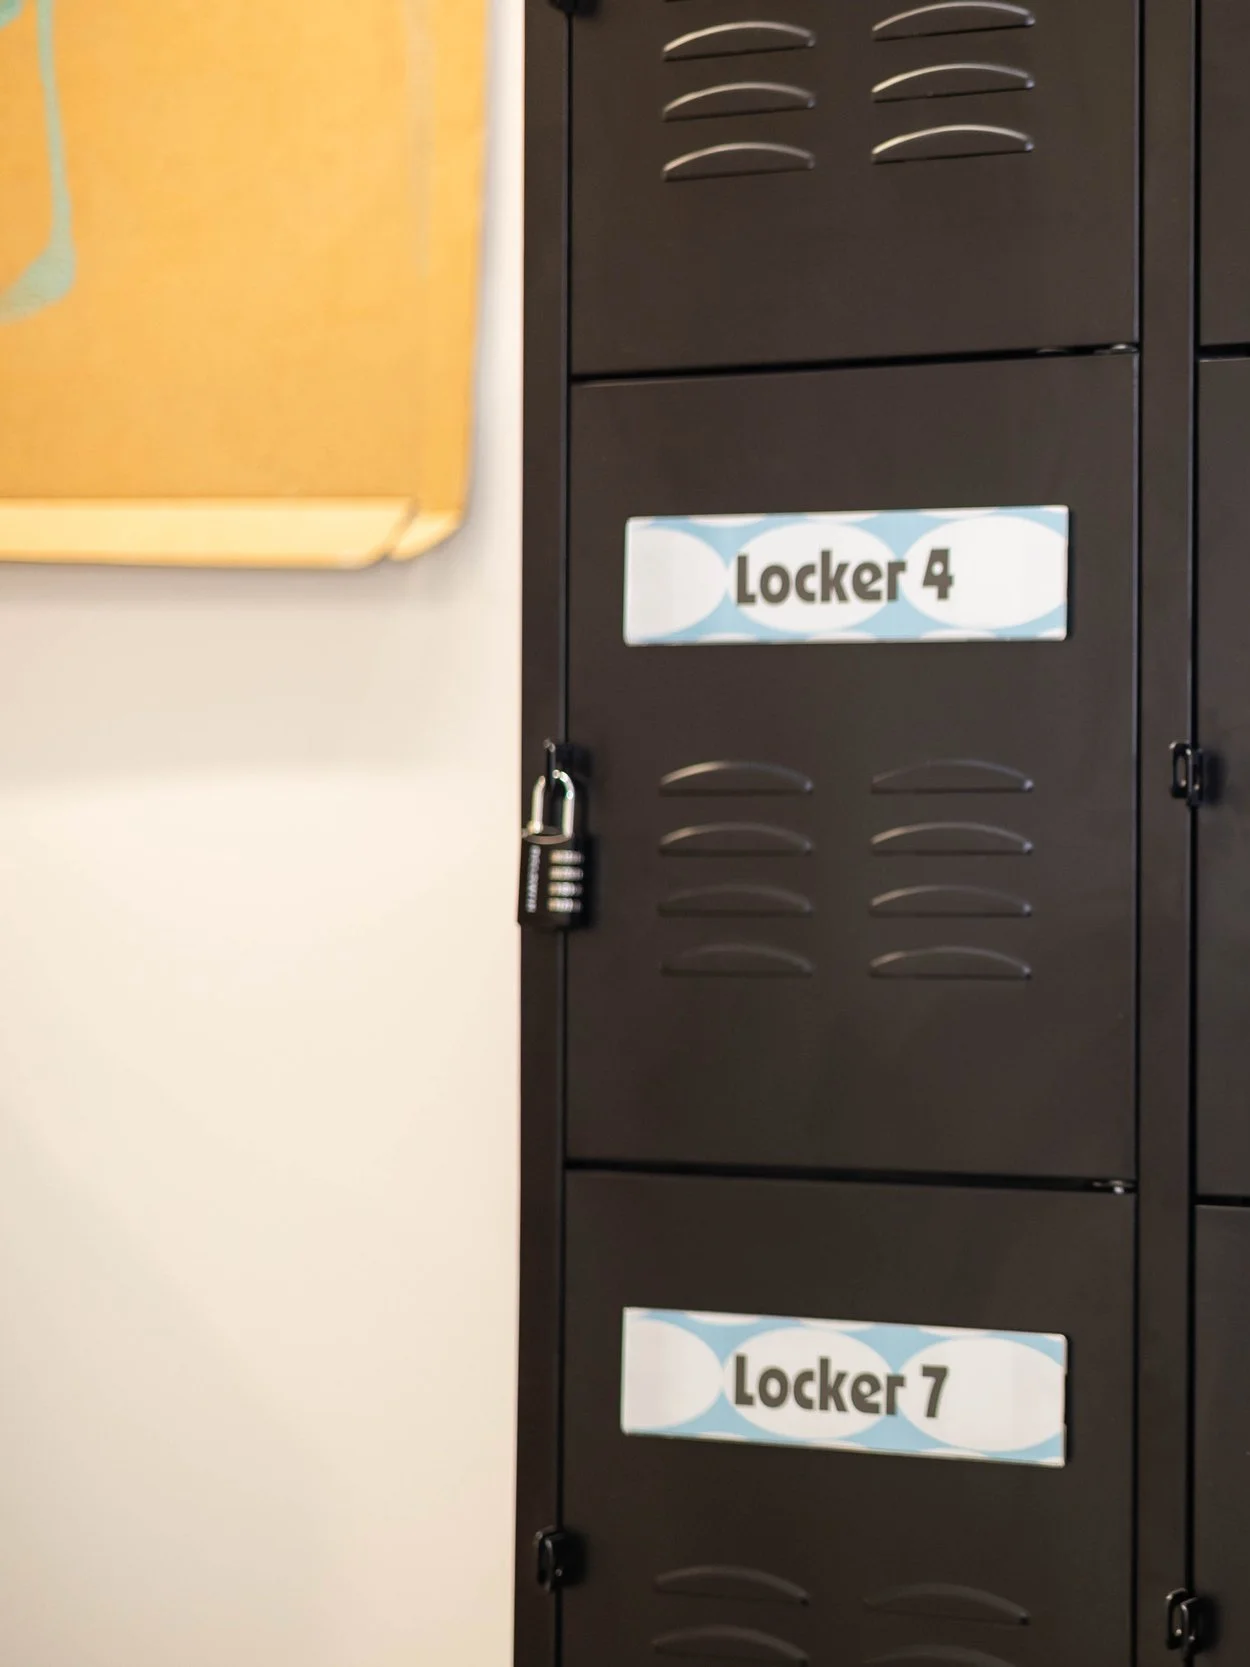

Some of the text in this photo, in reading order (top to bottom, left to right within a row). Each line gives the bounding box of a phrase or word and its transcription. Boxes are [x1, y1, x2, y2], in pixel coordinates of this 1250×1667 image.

[735, 548, 952, 605] Locker 4
[735, 1356, 948, 1418] Locker 7
